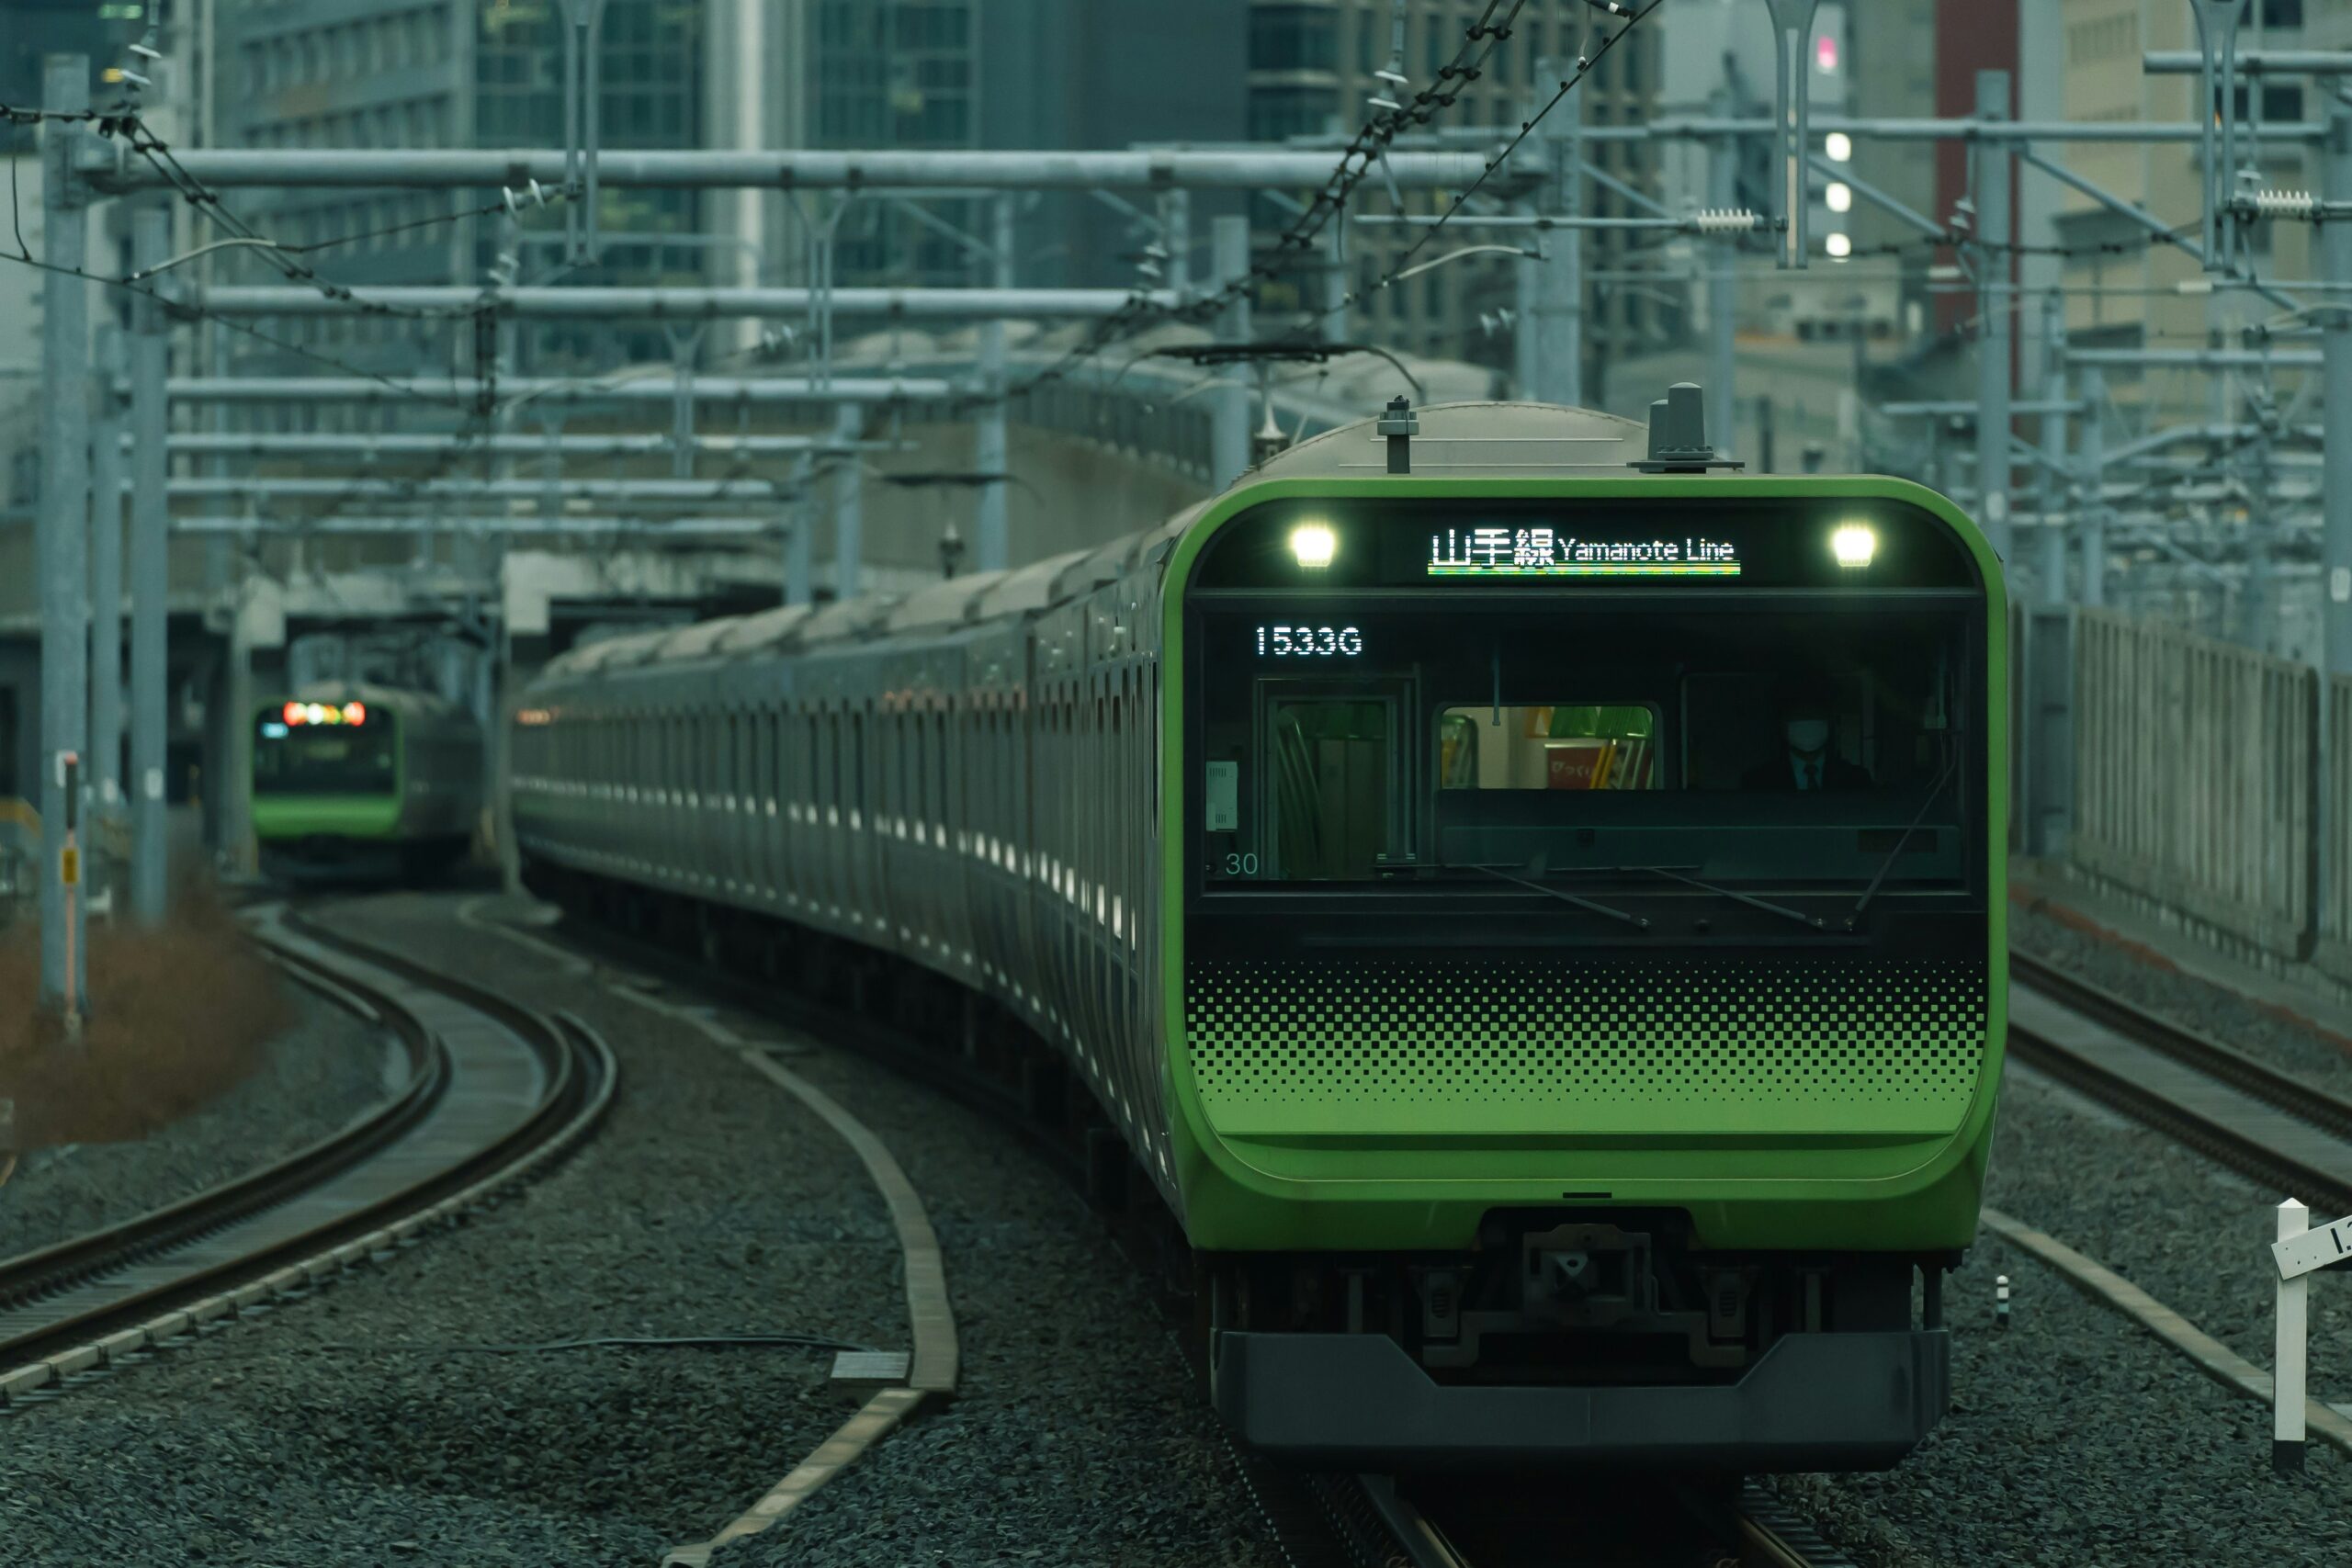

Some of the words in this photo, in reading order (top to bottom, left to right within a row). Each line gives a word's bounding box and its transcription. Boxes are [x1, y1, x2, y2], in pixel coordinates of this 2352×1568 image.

[1432, 528, 1555, 567] 山手線
[1558, 538, 1679, 561] Yamanote
[1686, 538, 1735, 561] Line
[1256, 626, 1363, 655] 1533G
[1225, 852, 1258, 874] 30
